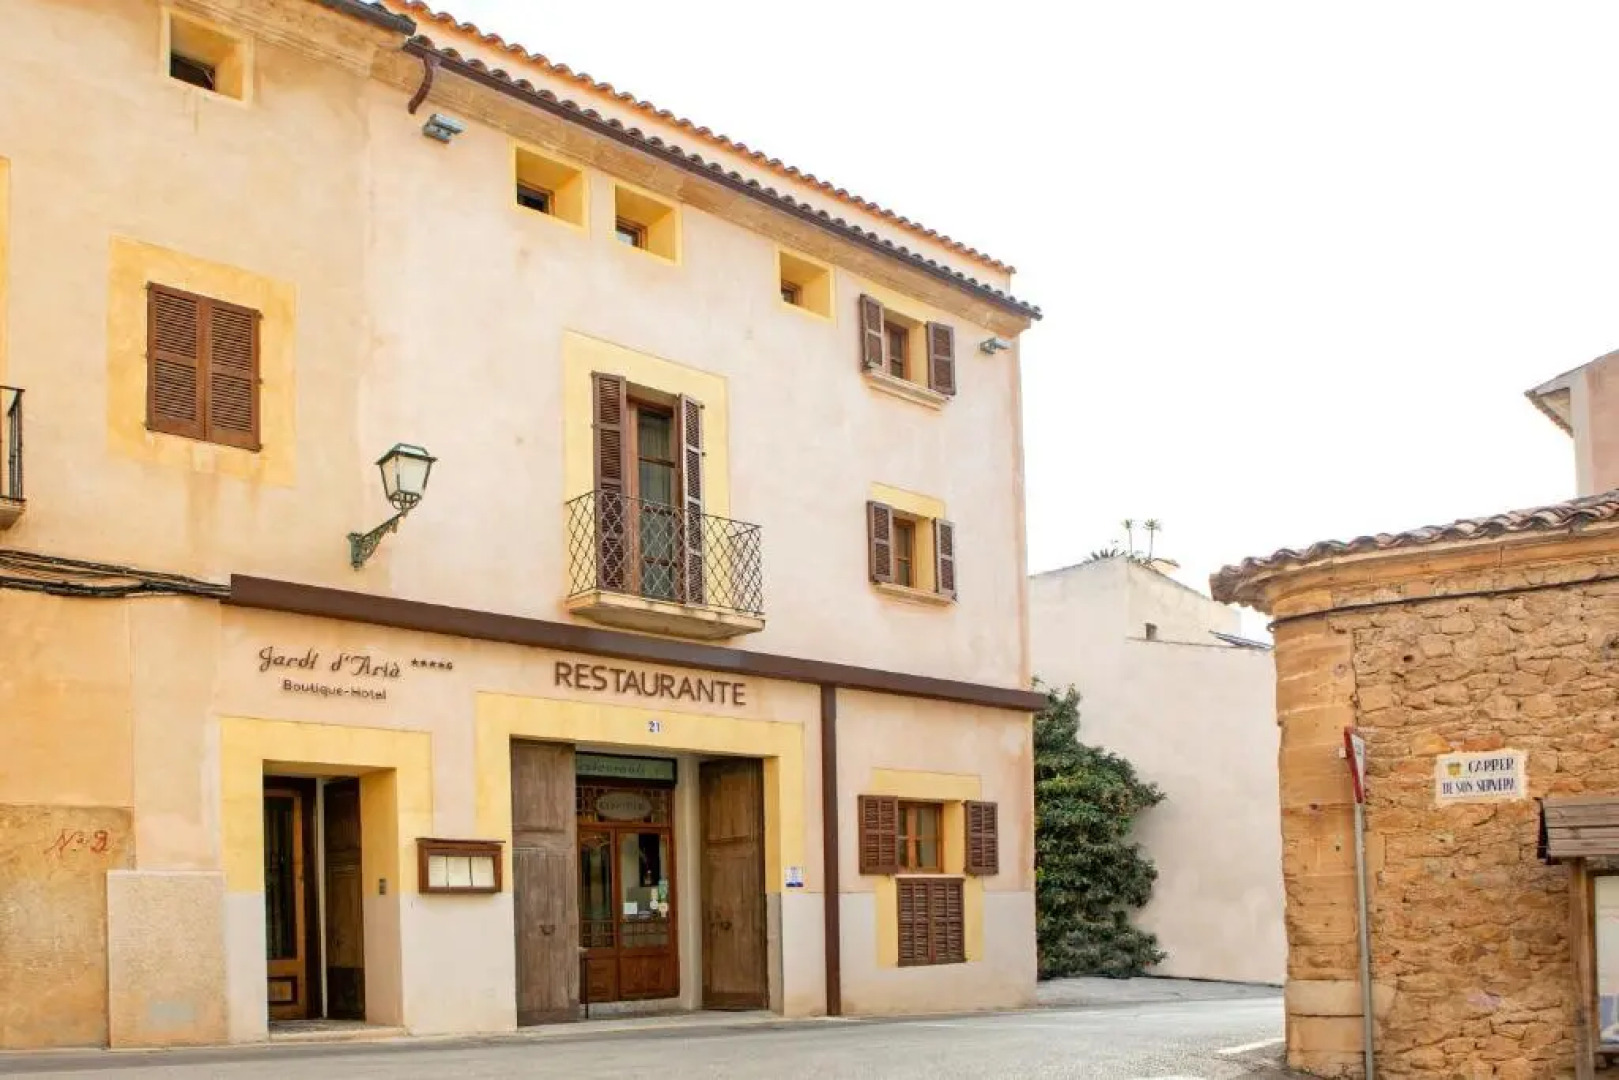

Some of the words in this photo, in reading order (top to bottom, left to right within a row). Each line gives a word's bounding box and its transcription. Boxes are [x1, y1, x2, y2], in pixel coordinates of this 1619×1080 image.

[283, 679, 387, 700] Boutique-Hotel
[554, 661, 747, 706] RESTAURANTE
[648, 720, 660, 733] 21
[1468, 758, 1514, 773] CARRER
[1442, 781, 1454, 795] DE
